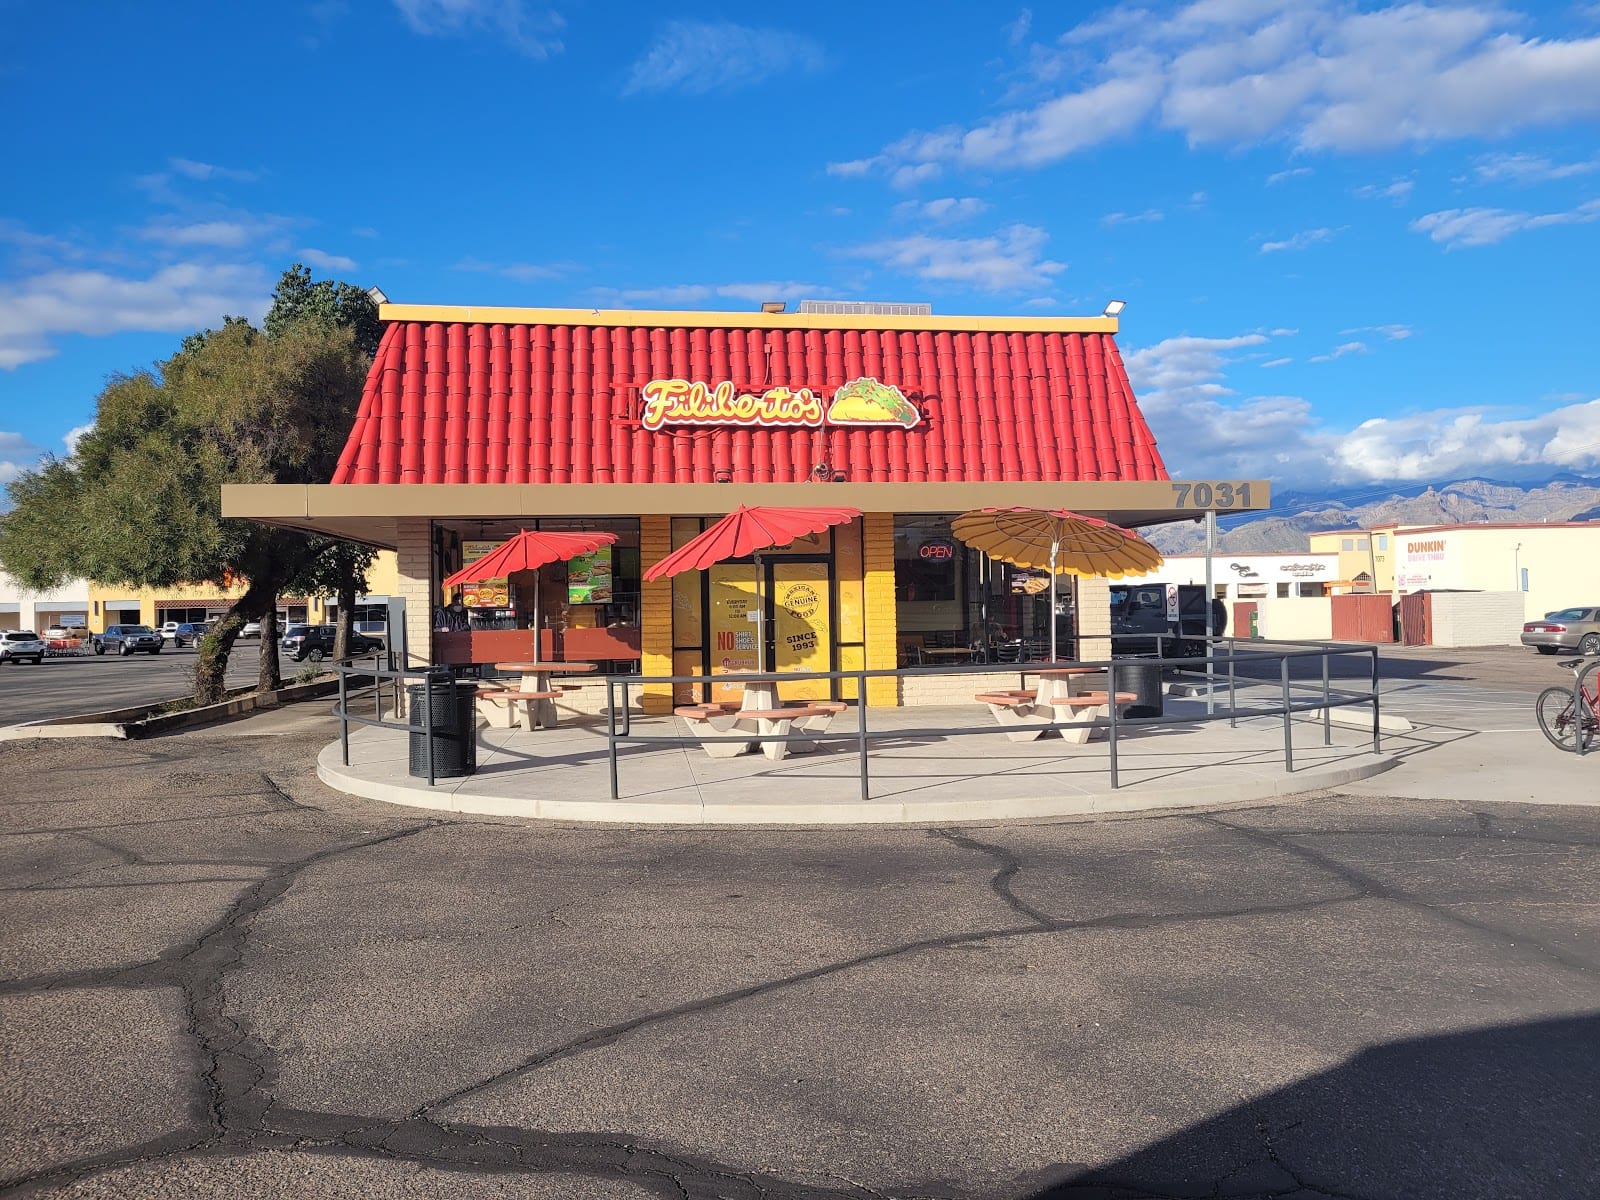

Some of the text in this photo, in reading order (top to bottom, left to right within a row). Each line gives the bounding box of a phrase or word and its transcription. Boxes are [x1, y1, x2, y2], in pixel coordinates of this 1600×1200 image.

[644, 379, 824, 429] Filiberto's
[1172, 483, 1250, 508] 7031
[920, 545, 953, 558] OPEN
[1408, 539, 1446, 553] DUNKIN'
[784, 595, 818, 607] GENUINE
[790, 609, 815, 619] FOOD
[717, 631, 735, 651] NO
[786, 632, 817, 644] SINCE
[791, 641, 815, 651] 1993
